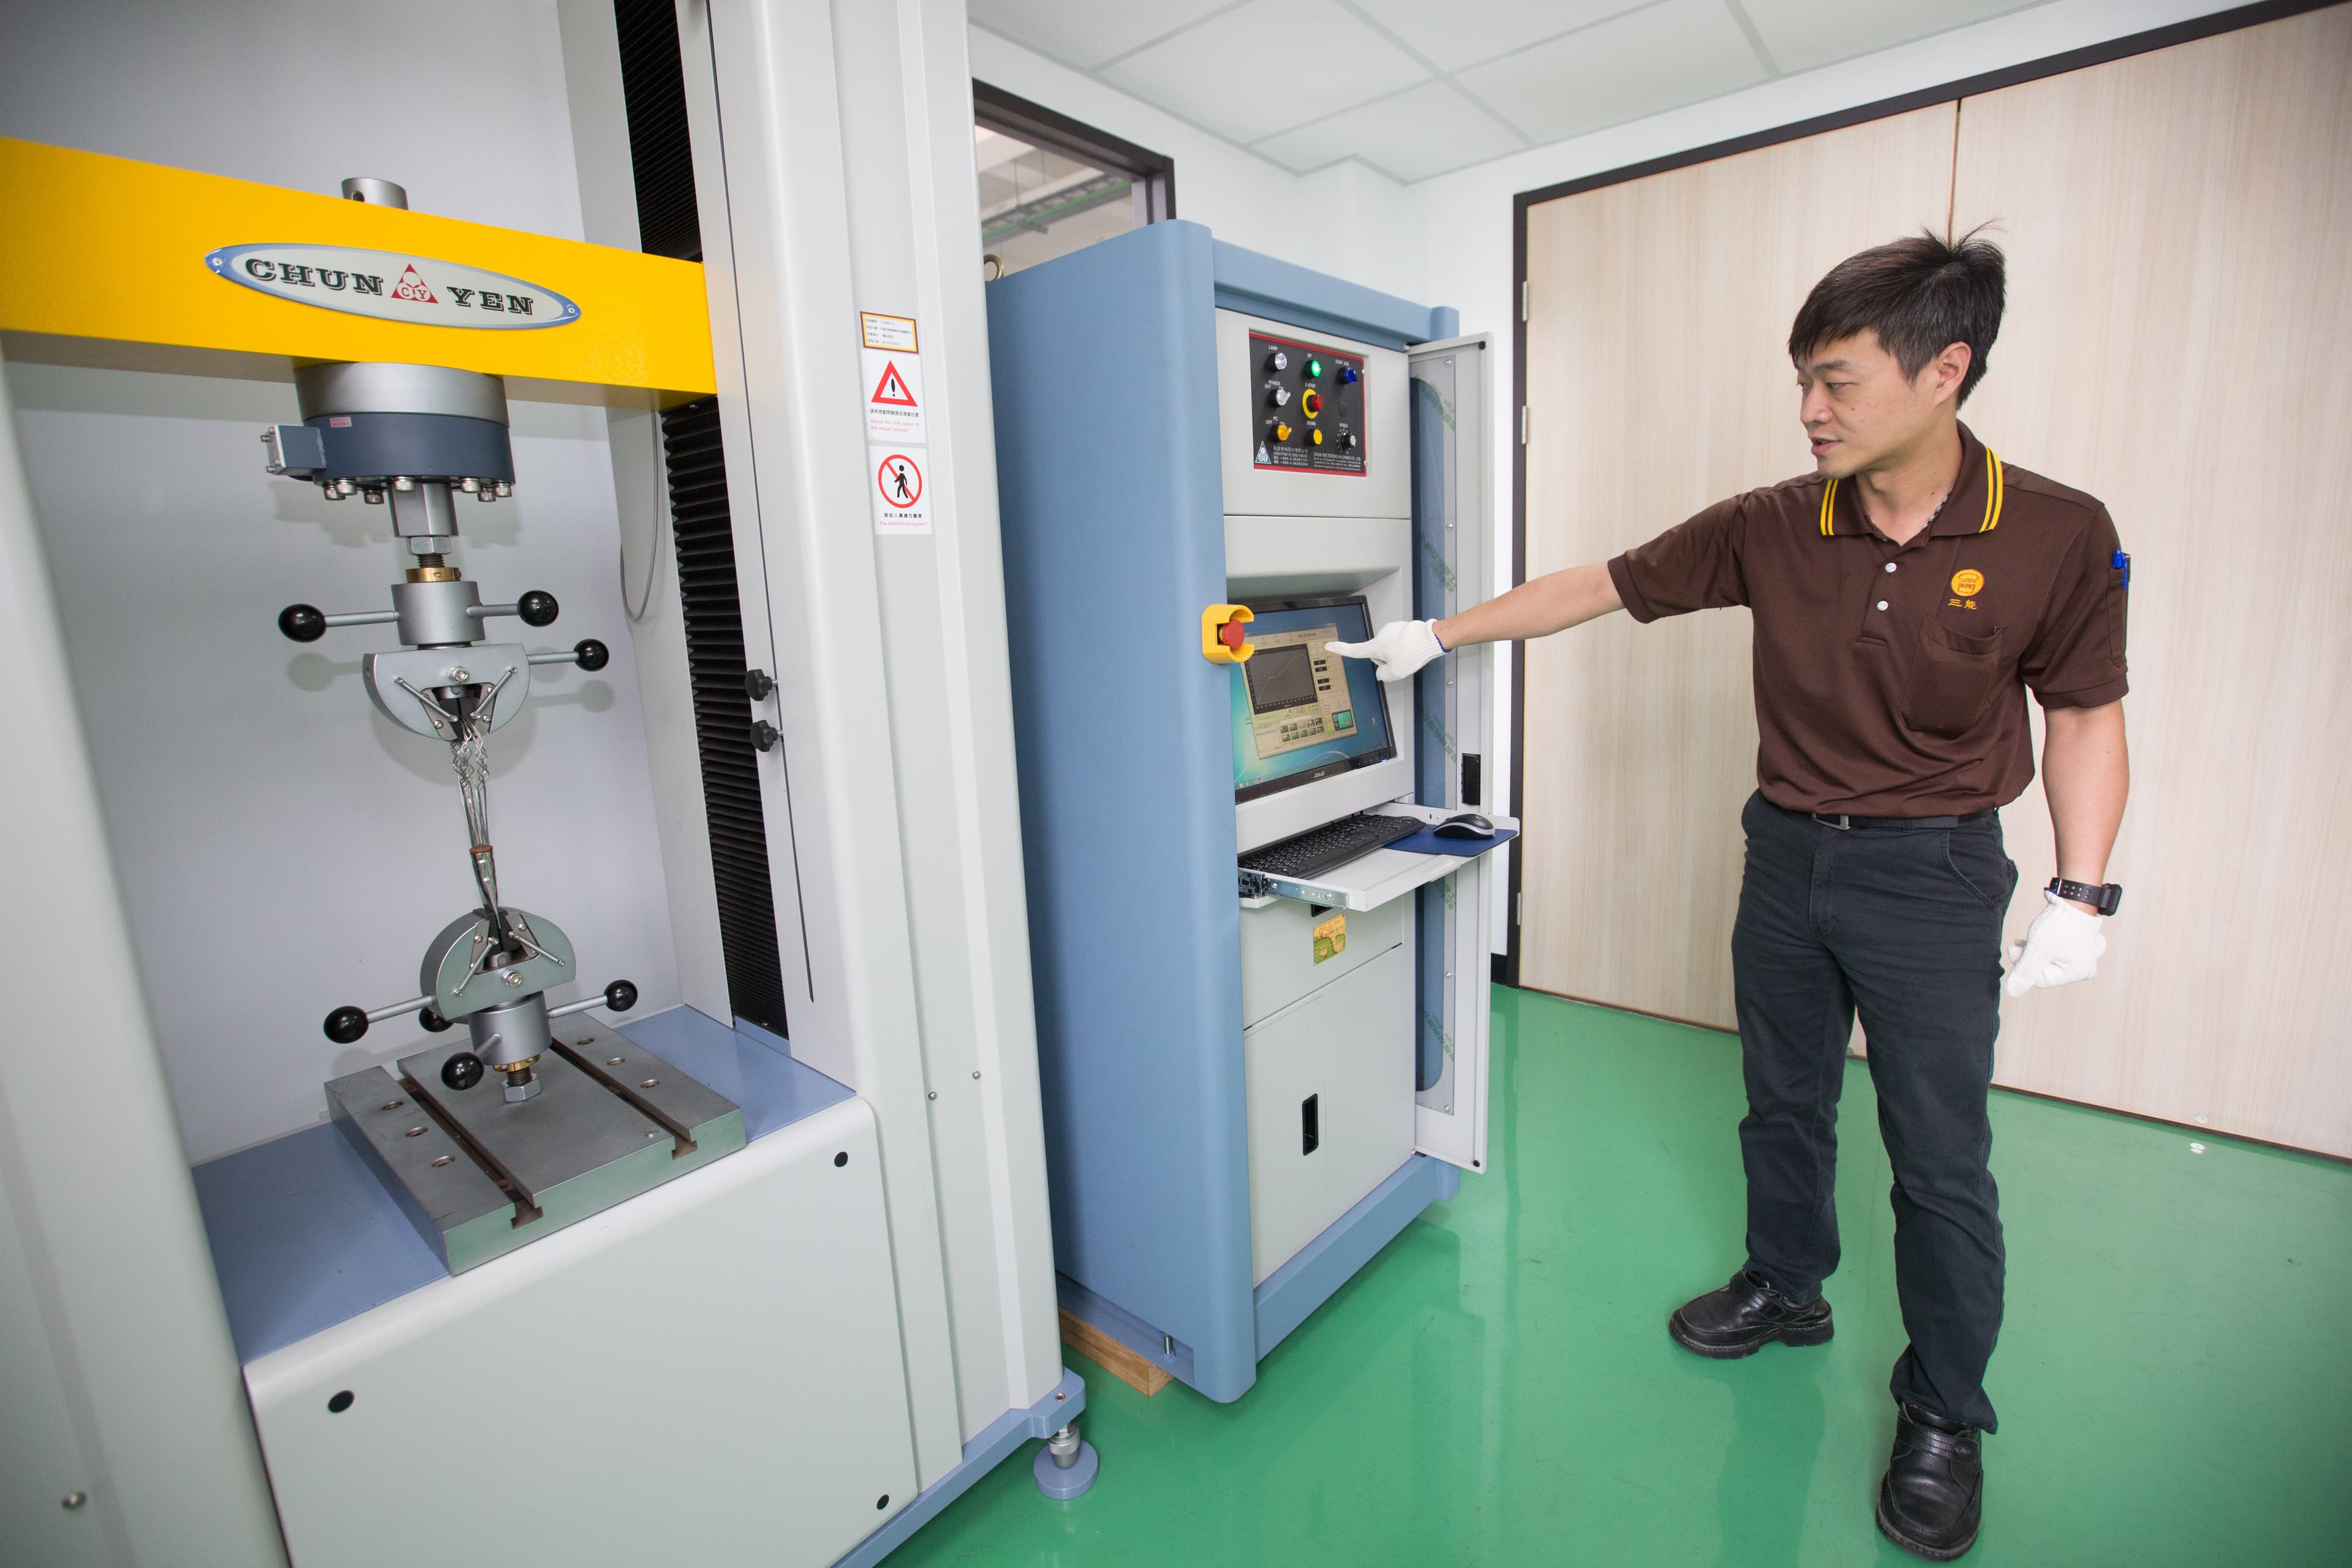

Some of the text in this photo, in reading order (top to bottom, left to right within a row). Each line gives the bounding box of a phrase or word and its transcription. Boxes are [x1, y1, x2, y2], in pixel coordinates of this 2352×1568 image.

[244, 258, 384, 295] CHUN
[447, 286, 533, 316] YEN
[1948, 598, 1978, 610] 三能
